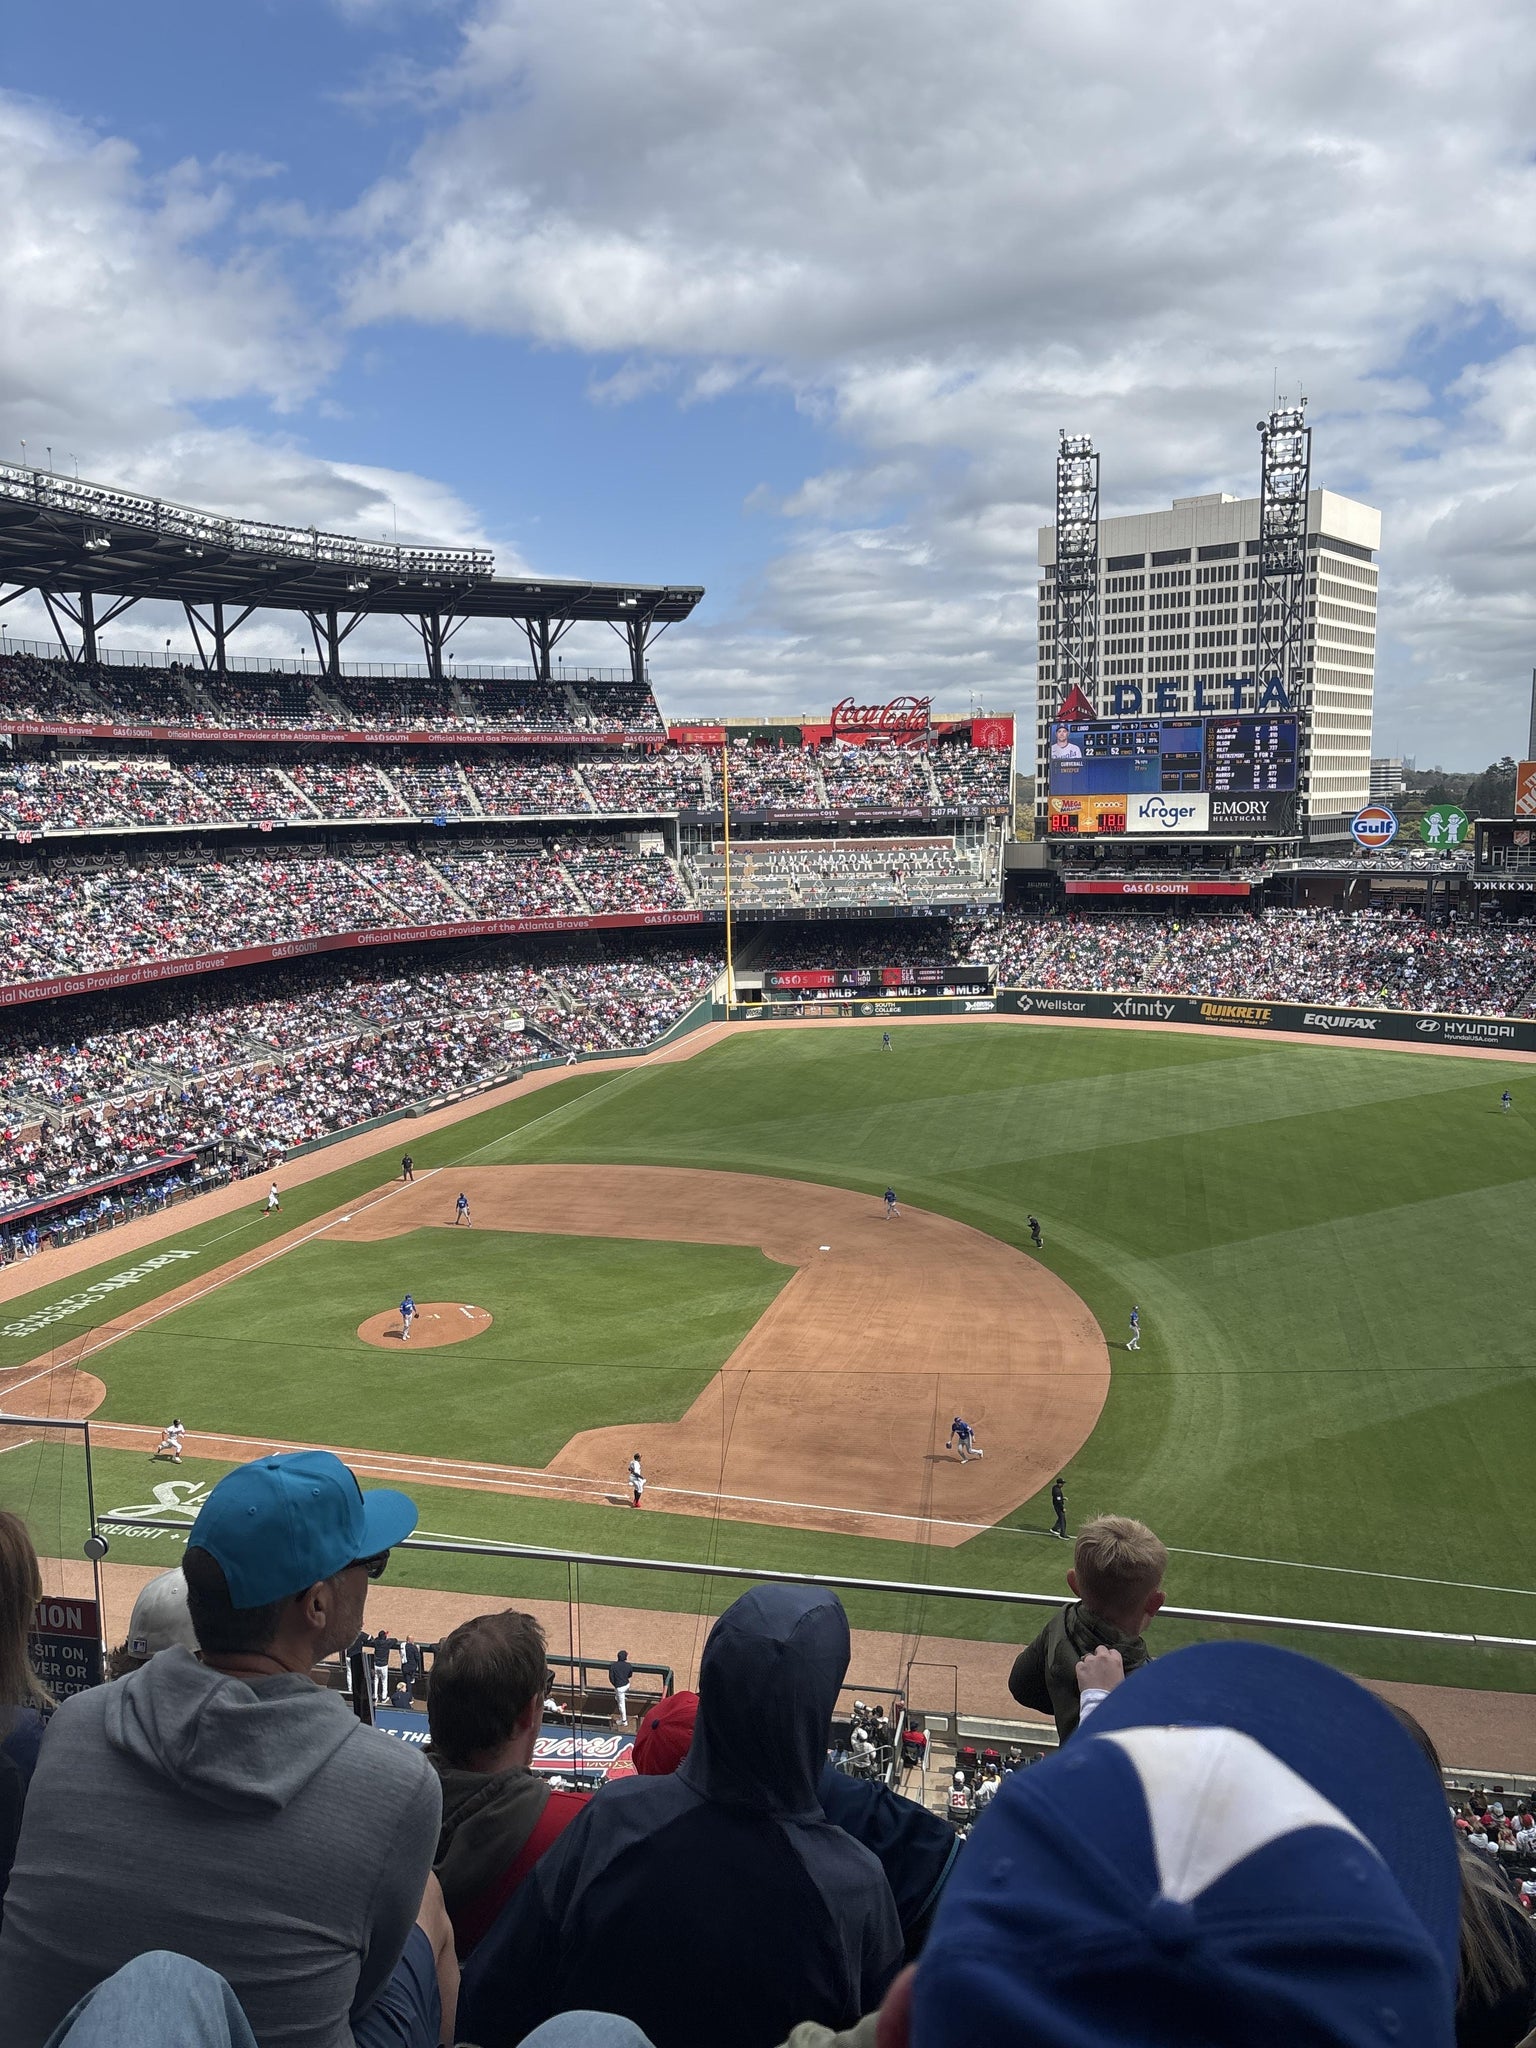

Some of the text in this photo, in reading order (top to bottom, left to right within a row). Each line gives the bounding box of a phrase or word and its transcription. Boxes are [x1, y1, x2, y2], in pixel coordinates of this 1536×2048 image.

[1114, 677, 1292, 714] DELTA
[18, 724, 26, 732] of
[40, 726, 68, 734] Atlanta
[113, 728, 153, 737] GAS SOUTH
[167, 730, 190, 738] Official
[239, 732, 270, 740] Provider
[271, 732, 279, 740] of
[294, 733, 320, 741] Atlanta
[1085, 748, 1094, 756] 22
[1110, 747, 1120, 755] 52
[1136, 746, 1145, 754] 74
[1139, 797, 1196, 828] Kroger
[1213, 801, 1270, 815] EMORY
[1052, 815, 1069, 827] 80
[1103, 814, 1125, 826] 180
[1354, 820, 1393, 834] Gulf
[16, 830, 32, 843] 44
[769, 851, 956, 873] HANK AARON TERRACE
[1123, 884, 1188, 893] GAS SOUTH
[644, 913, 699, 924] GAS SOUTH
[357, 932, 392, 944] Official
[393, 929, 428, 941] Natural
[430, 927, 447, 937] Gas
[449, 924, 485, 936] Provider
[487, 923, 498, 932] of
[499, 922, 516, 931] the
[518, 920, 555, 930] Atlanta
[271, 942, 318, 957] GAS SOUTH
[18, 983, 62, 1001] Natural
[64, 981, 85, 992] Gas
[87, 974, 129, 989] Provider
[131, 972, 142, 981] of
[143, 969, 159, 978] the
[160, 963, 194, 976] Atlanta
[770, 976, 791, 985] GAS
[842, 974, 854, 983] AL
[829, 989, 858, 998] MLB+
[898, 986, 927, 997] MLB+
[956, 985, 986, 995] MLB+
[1035, 999, 1086, 1012] Wellstar
[1112, 997, 1176, 1019] xfinity
[1200, 1002, 1272, 1020] QUIKRETE
[1303, 1013, 1377, 1030] EQUIFAX
[1444, 1022, 1515, 1037] HYUNDAI
[1444, 1033, 1499, 1044] HyundaiUSA.com
[8, 1294, 106, 1338] CHEROKEE
[34, 1643, 89, 1664] SIT ON,
[65, 1664, 87, 1679] OR
[401, 1731, 432, 1744] THE
[951, 1792, 967, 1807] 23
